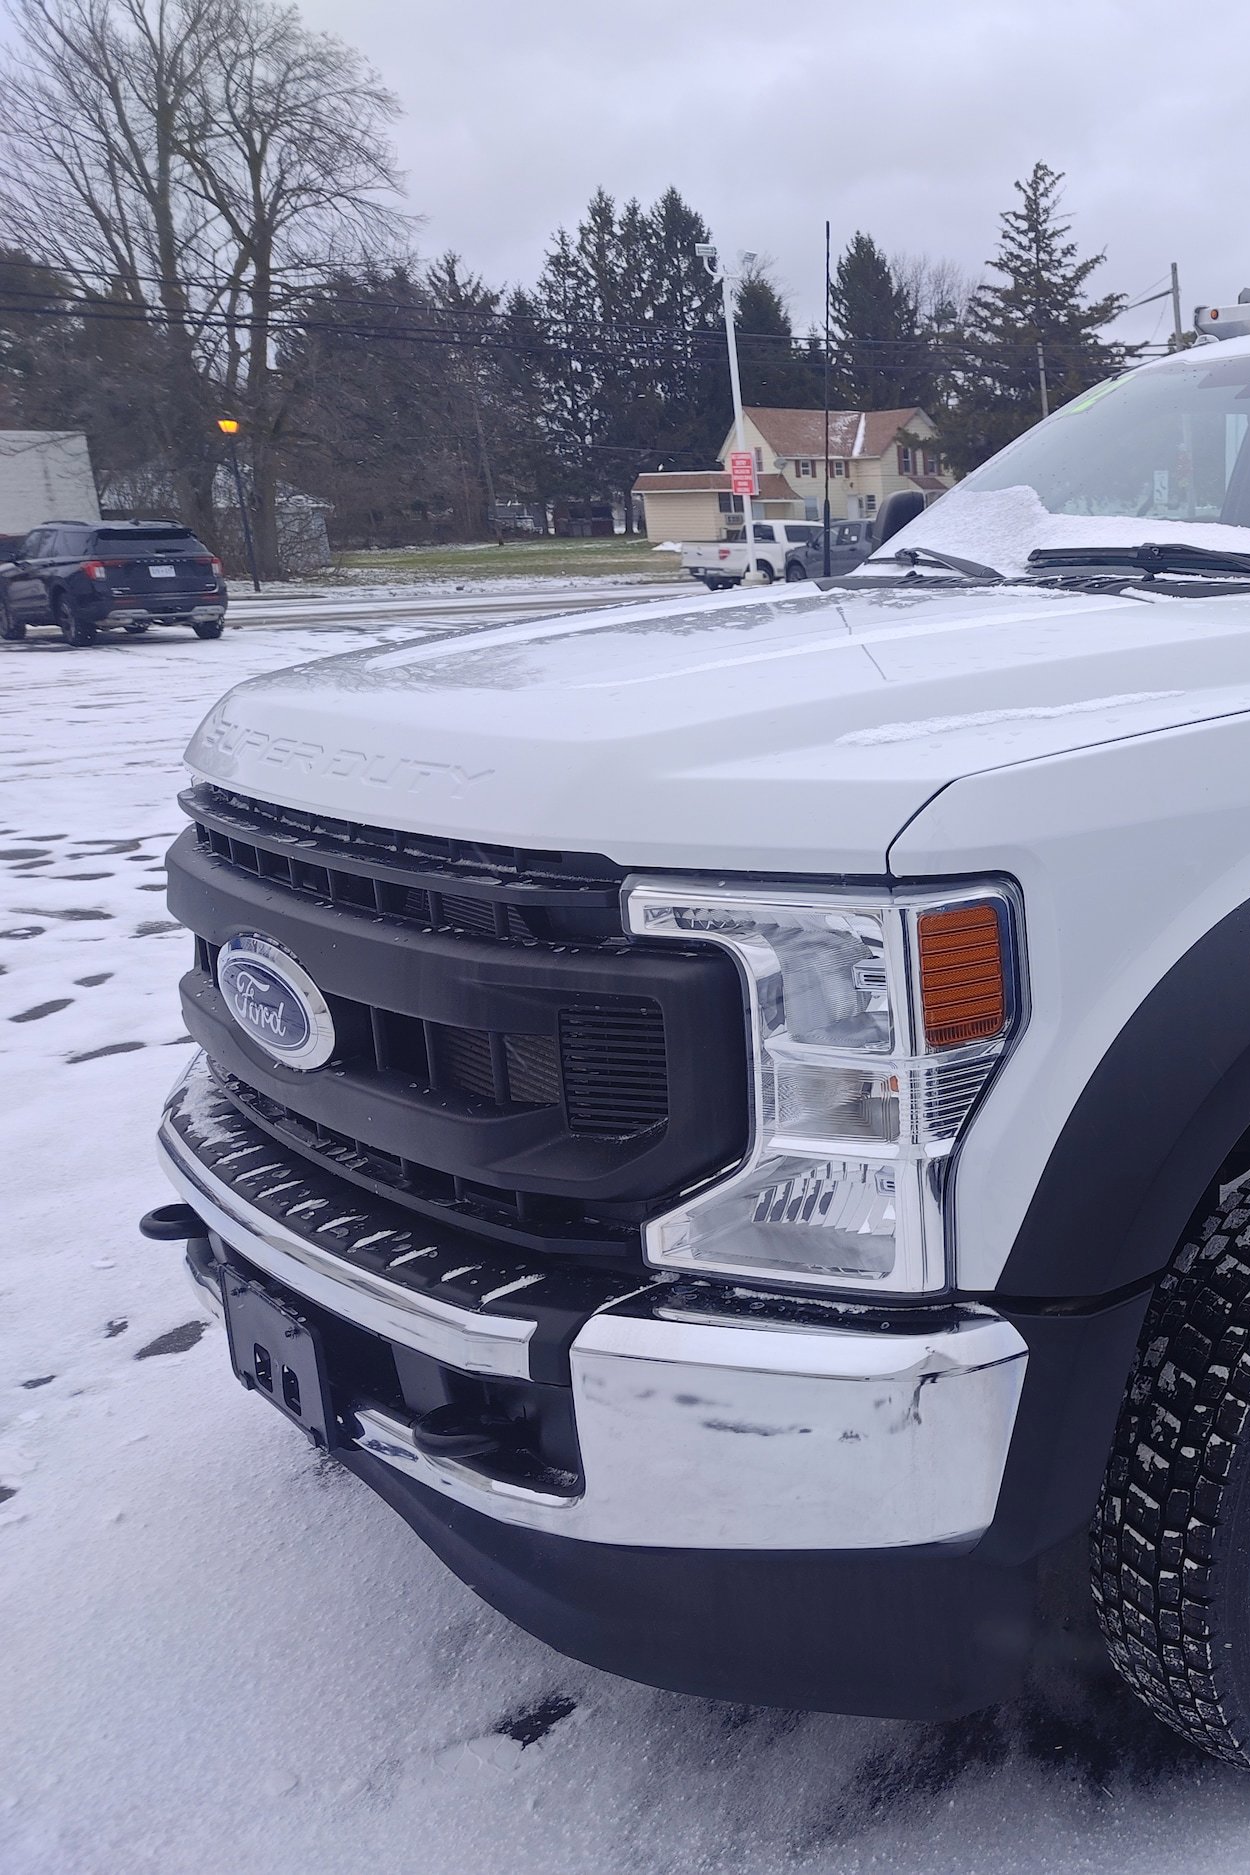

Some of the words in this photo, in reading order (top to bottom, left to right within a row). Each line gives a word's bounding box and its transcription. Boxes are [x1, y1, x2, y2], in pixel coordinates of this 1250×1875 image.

[201, 718, 325, 776] SUPER
[320, 745, 496, 801] DUTY
[234, 970, 288, 1037] Ford
